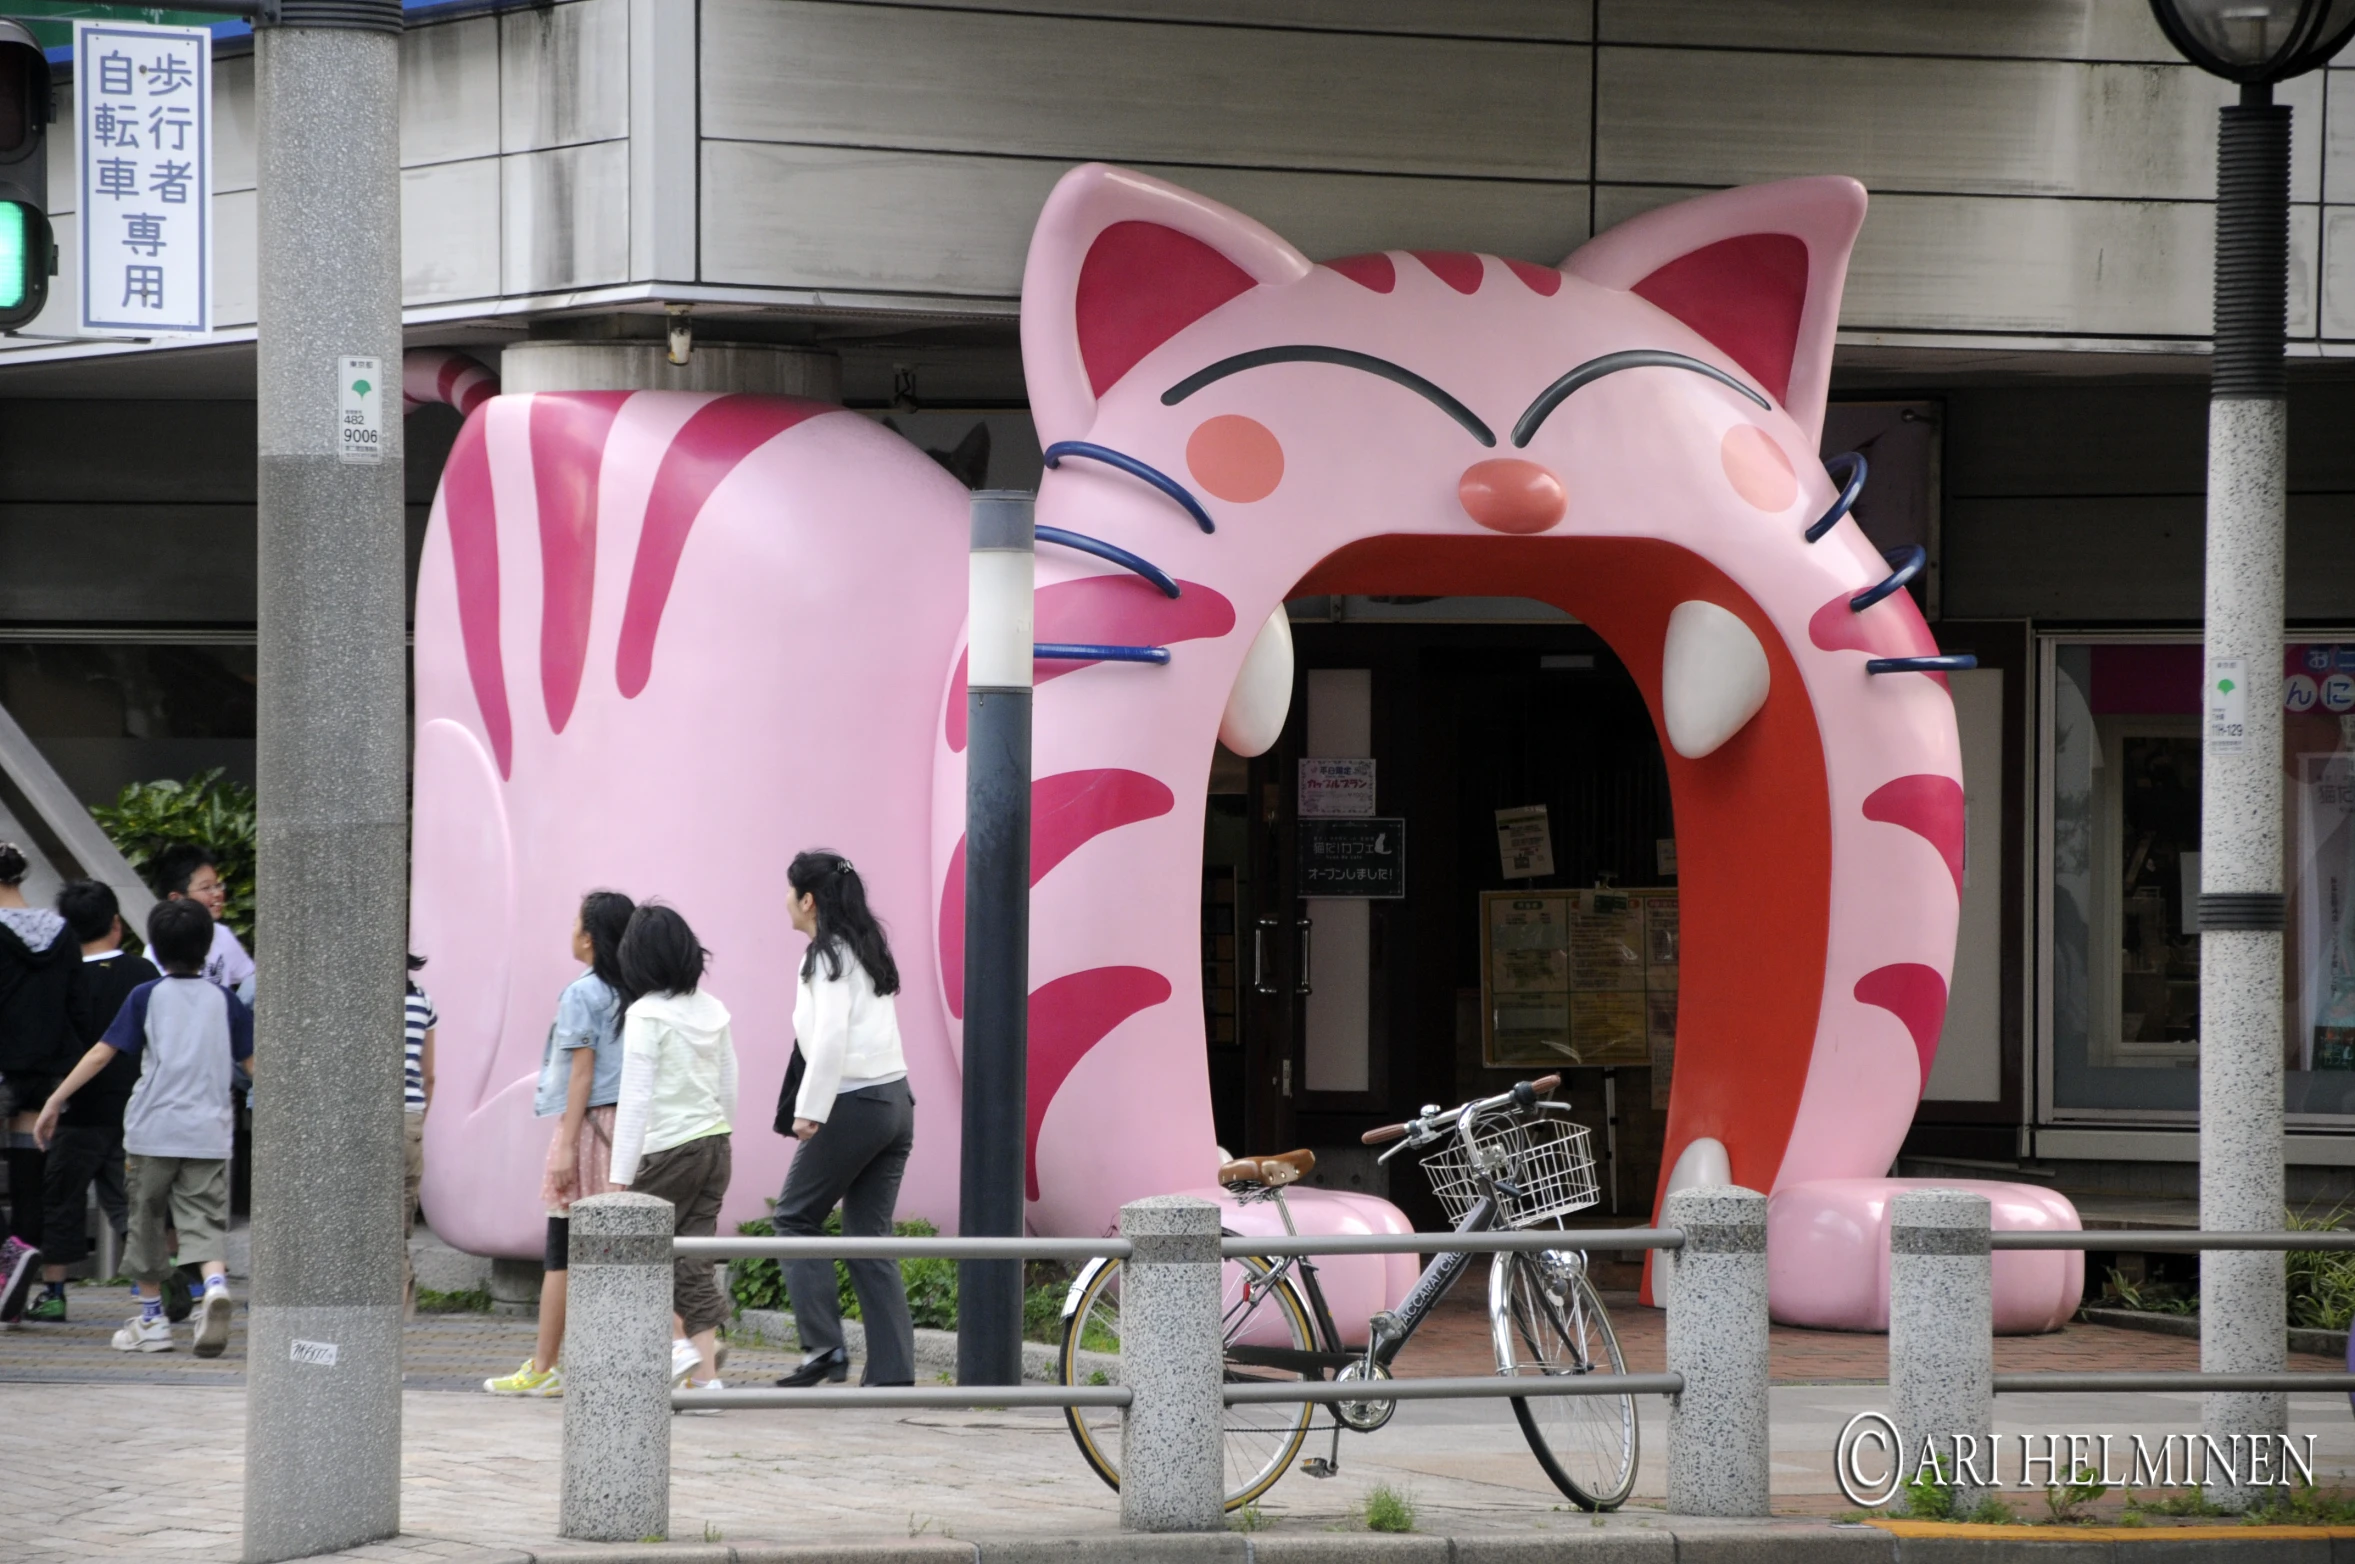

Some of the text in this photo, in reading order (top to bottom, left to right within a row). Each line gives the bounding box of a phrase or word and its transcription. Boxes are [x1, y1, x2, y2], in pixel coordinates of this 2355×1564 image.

[94, 50, 140, 201] 自転車
[147, 53, 193, 205] 歩行者
[121, 213, 167, 310] 専用
[344, 415, 364, 425] 482
[344, 428, 378, 443] 9006
[1308, 867, 1393, 881] オープンしました!
